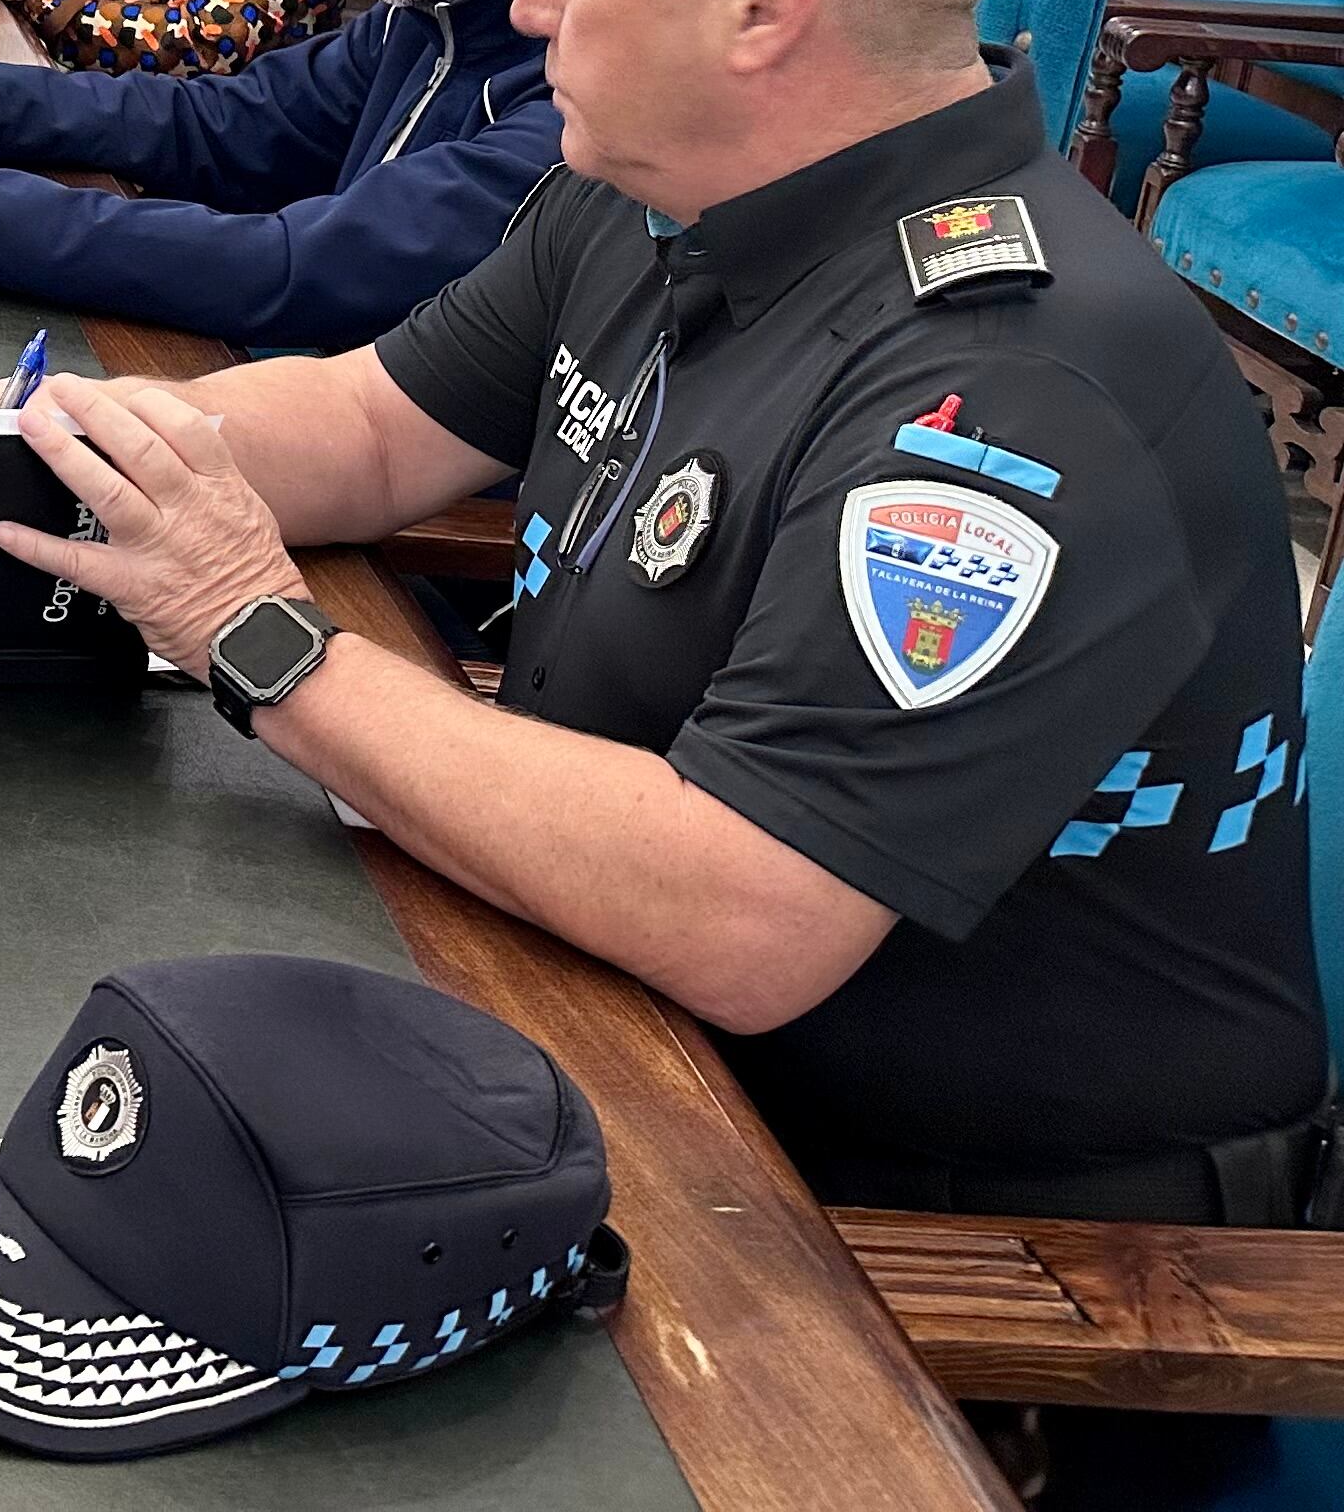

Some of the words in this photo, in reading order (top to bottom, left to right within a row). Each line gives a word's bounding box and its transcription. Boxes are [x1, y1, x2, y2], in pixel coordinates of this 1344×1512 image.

[556, 414, 591, 464] LOCAL
[889, 511, 958, 529] POLICIA
[964, 521, 1014, 557] LOCAL
[871, 567, 932, 592] TALAVERA
[933, 585, 950, 597] DE
[952, 589, 967, 601] LA
[970, 593, 1003, 611] REINA
